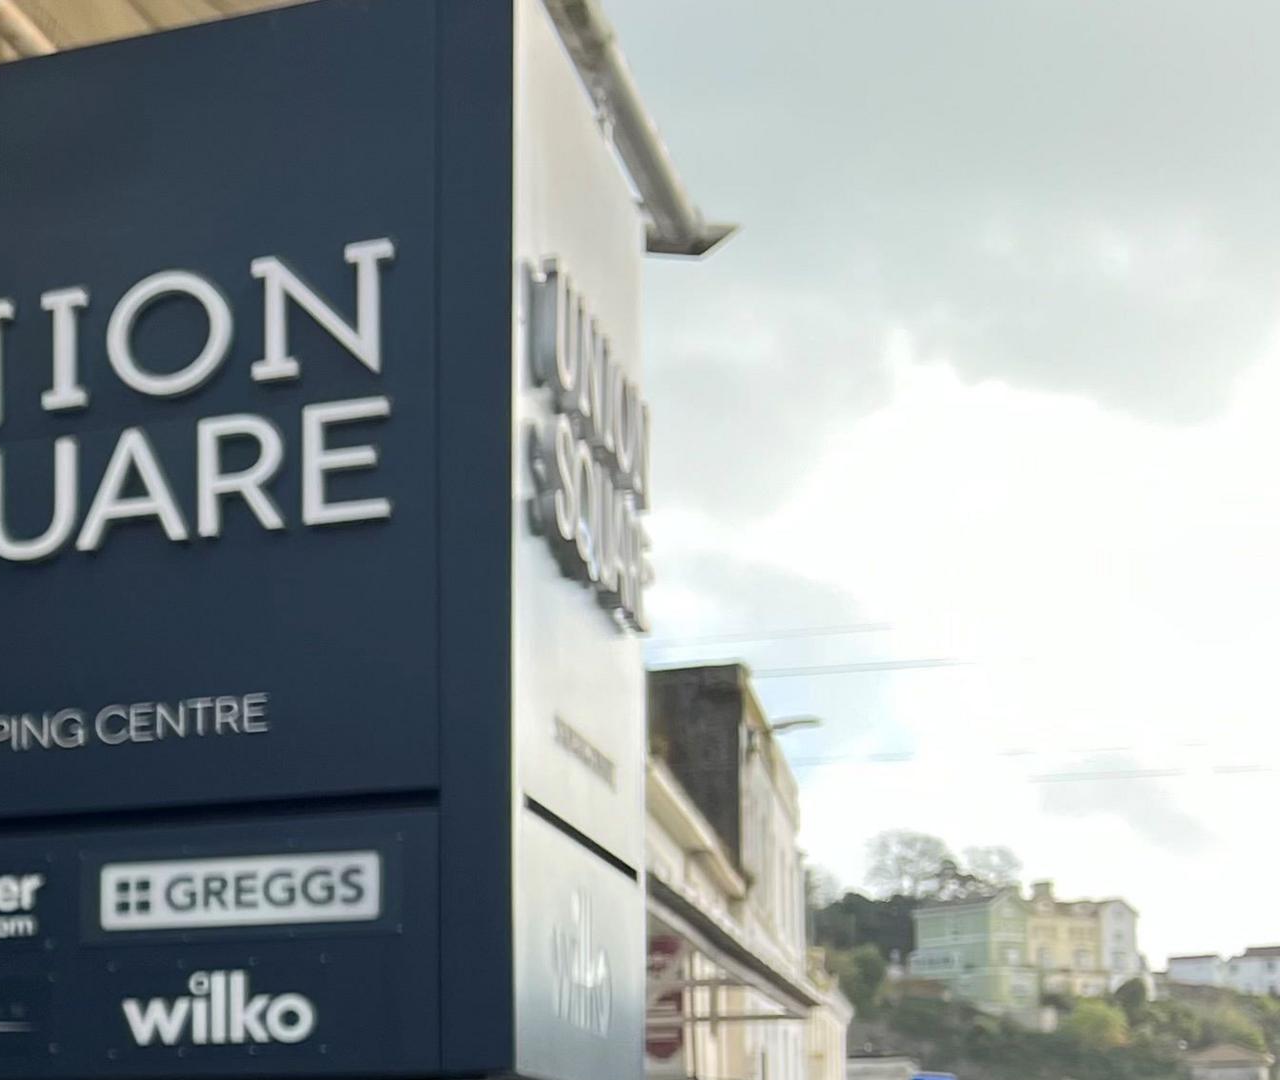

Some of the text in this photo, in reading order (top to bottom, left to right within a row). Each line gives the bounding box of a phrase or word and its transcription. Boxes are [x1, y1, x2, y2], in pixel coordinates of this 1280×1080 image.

[95, 692, 270, 746] CENTRE
[164, 867, 365, 912] GREGGS
[121, 969, 316, 1046] wilko
